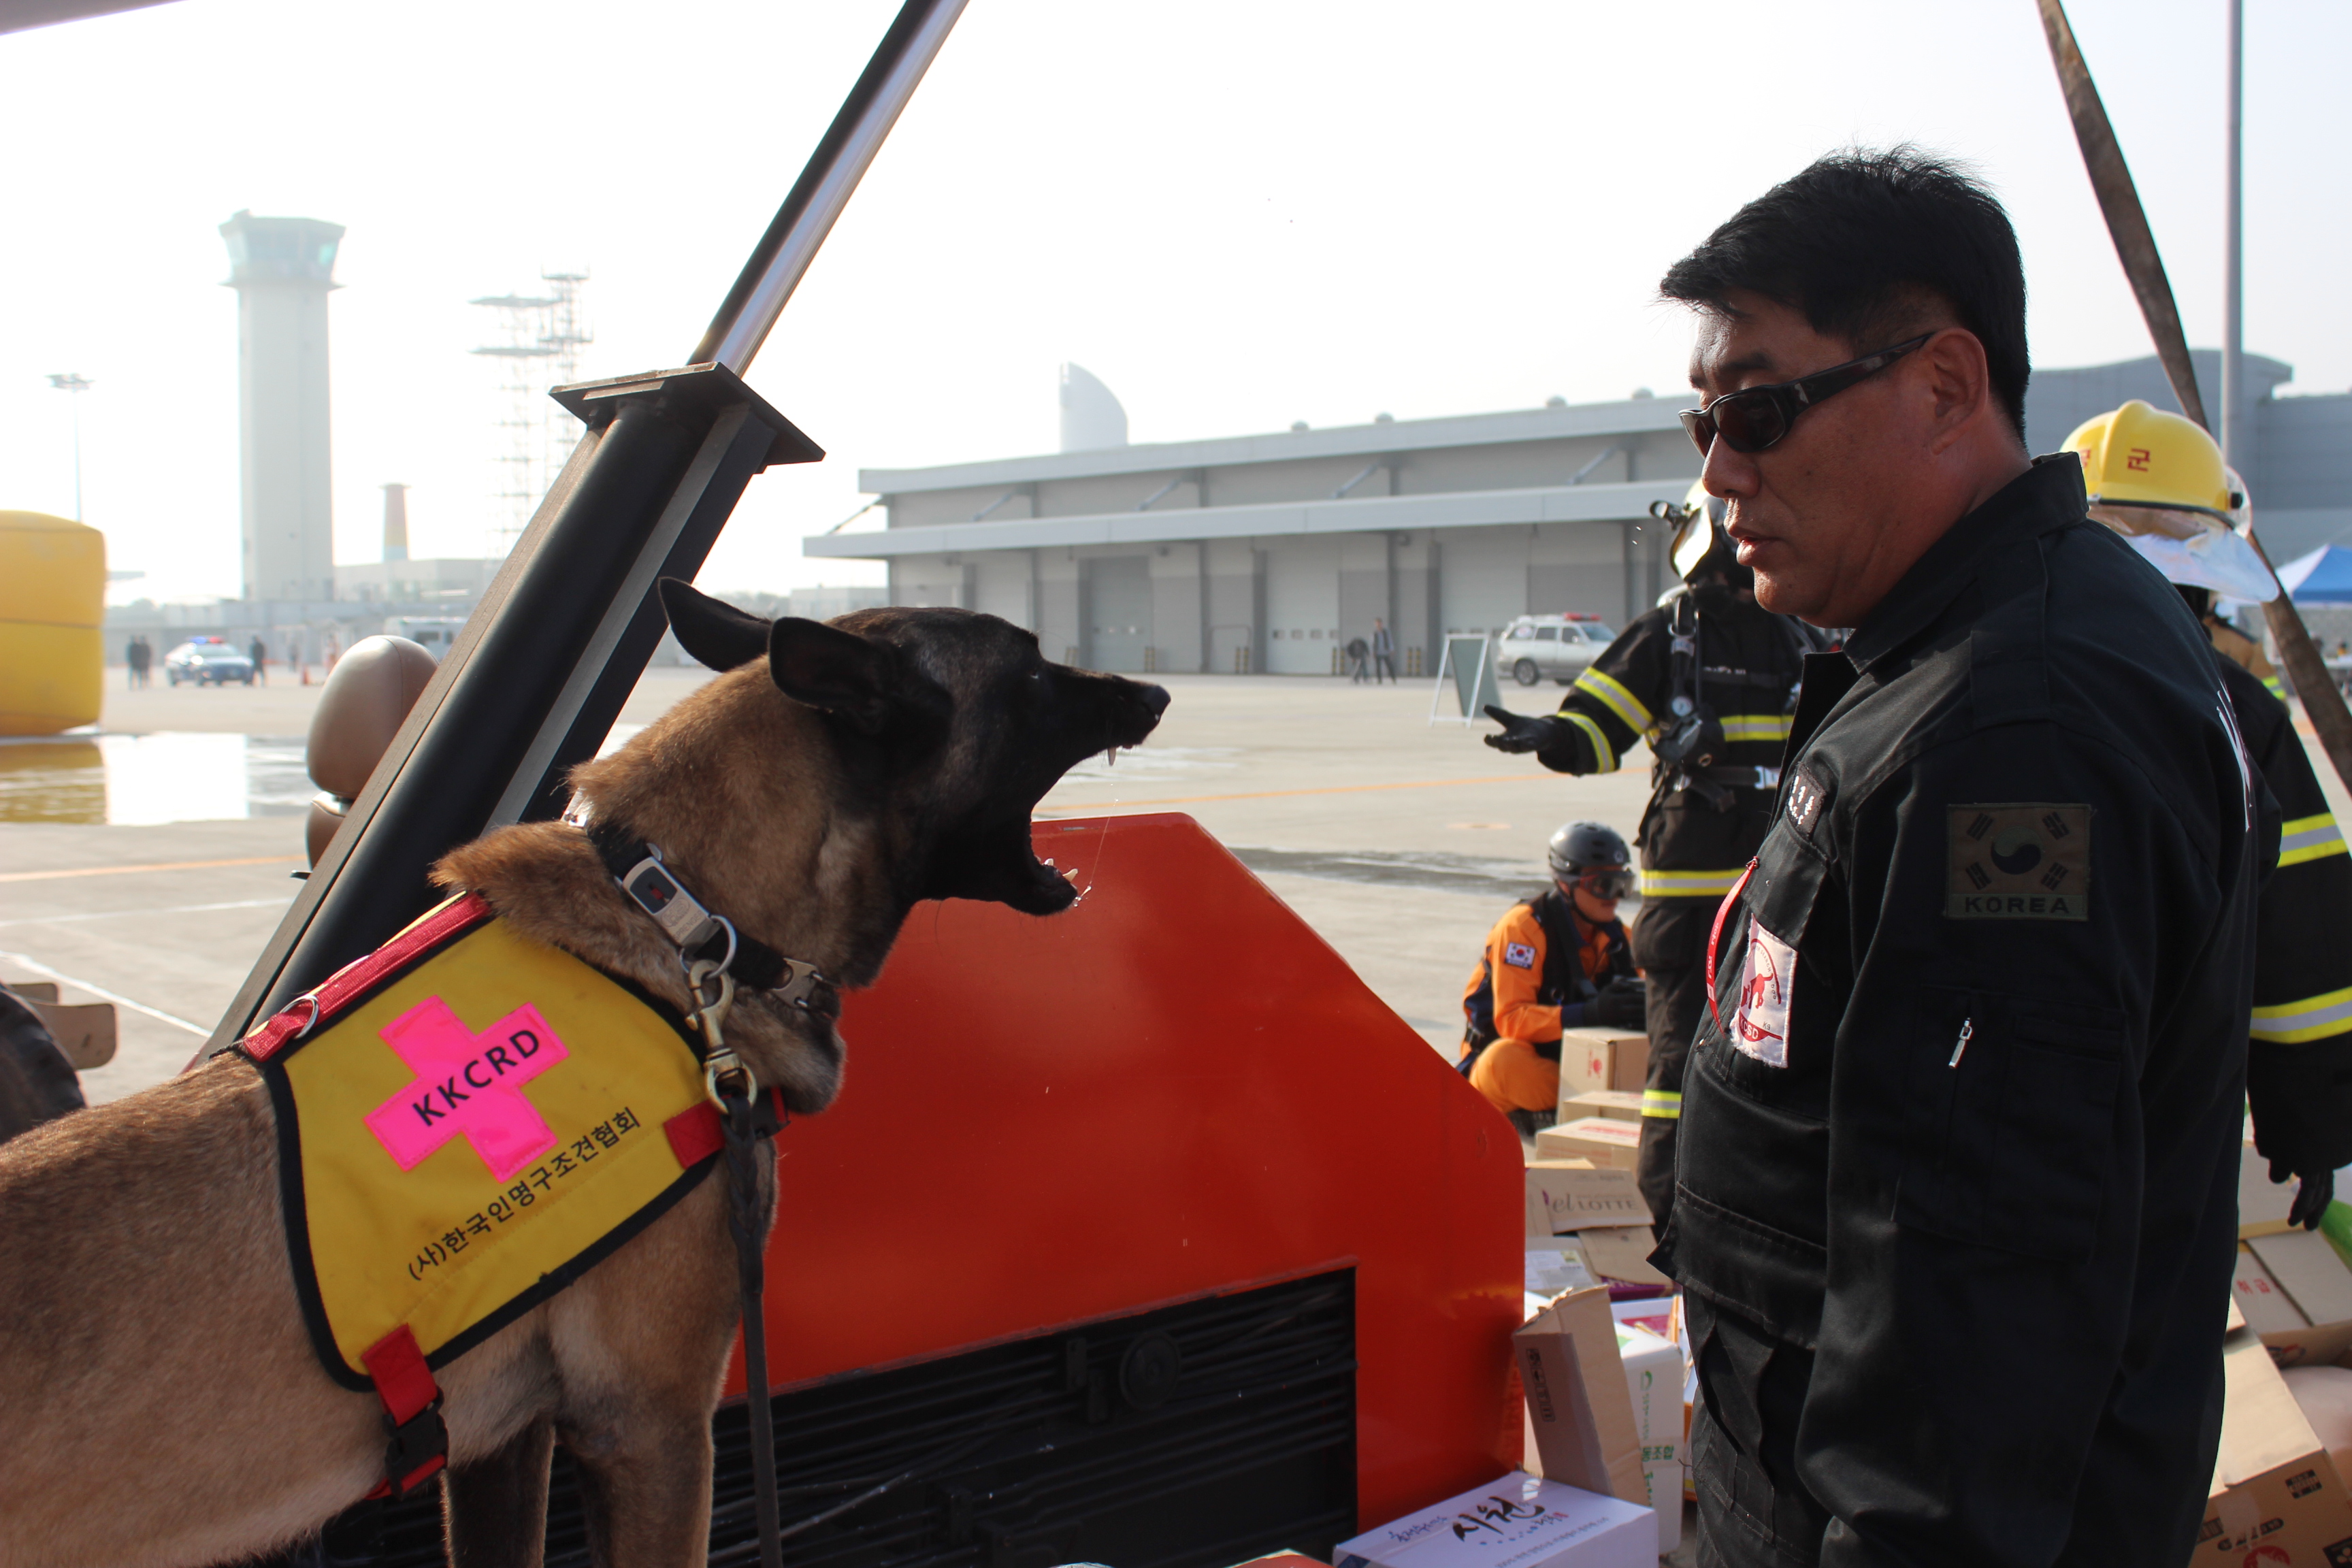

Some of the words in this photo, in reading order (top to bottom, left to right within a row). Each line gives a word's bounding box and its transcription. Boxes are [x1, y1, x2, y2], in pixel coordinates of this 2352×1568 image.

[1965, 896, 2070, 914] KOREA
[1740, 1017, 1759, 1040] KCSD
[412, 1028, 541, 1127] KKCRD
[408, 1107, 641, 1281] (사)한국인명구조견협회
